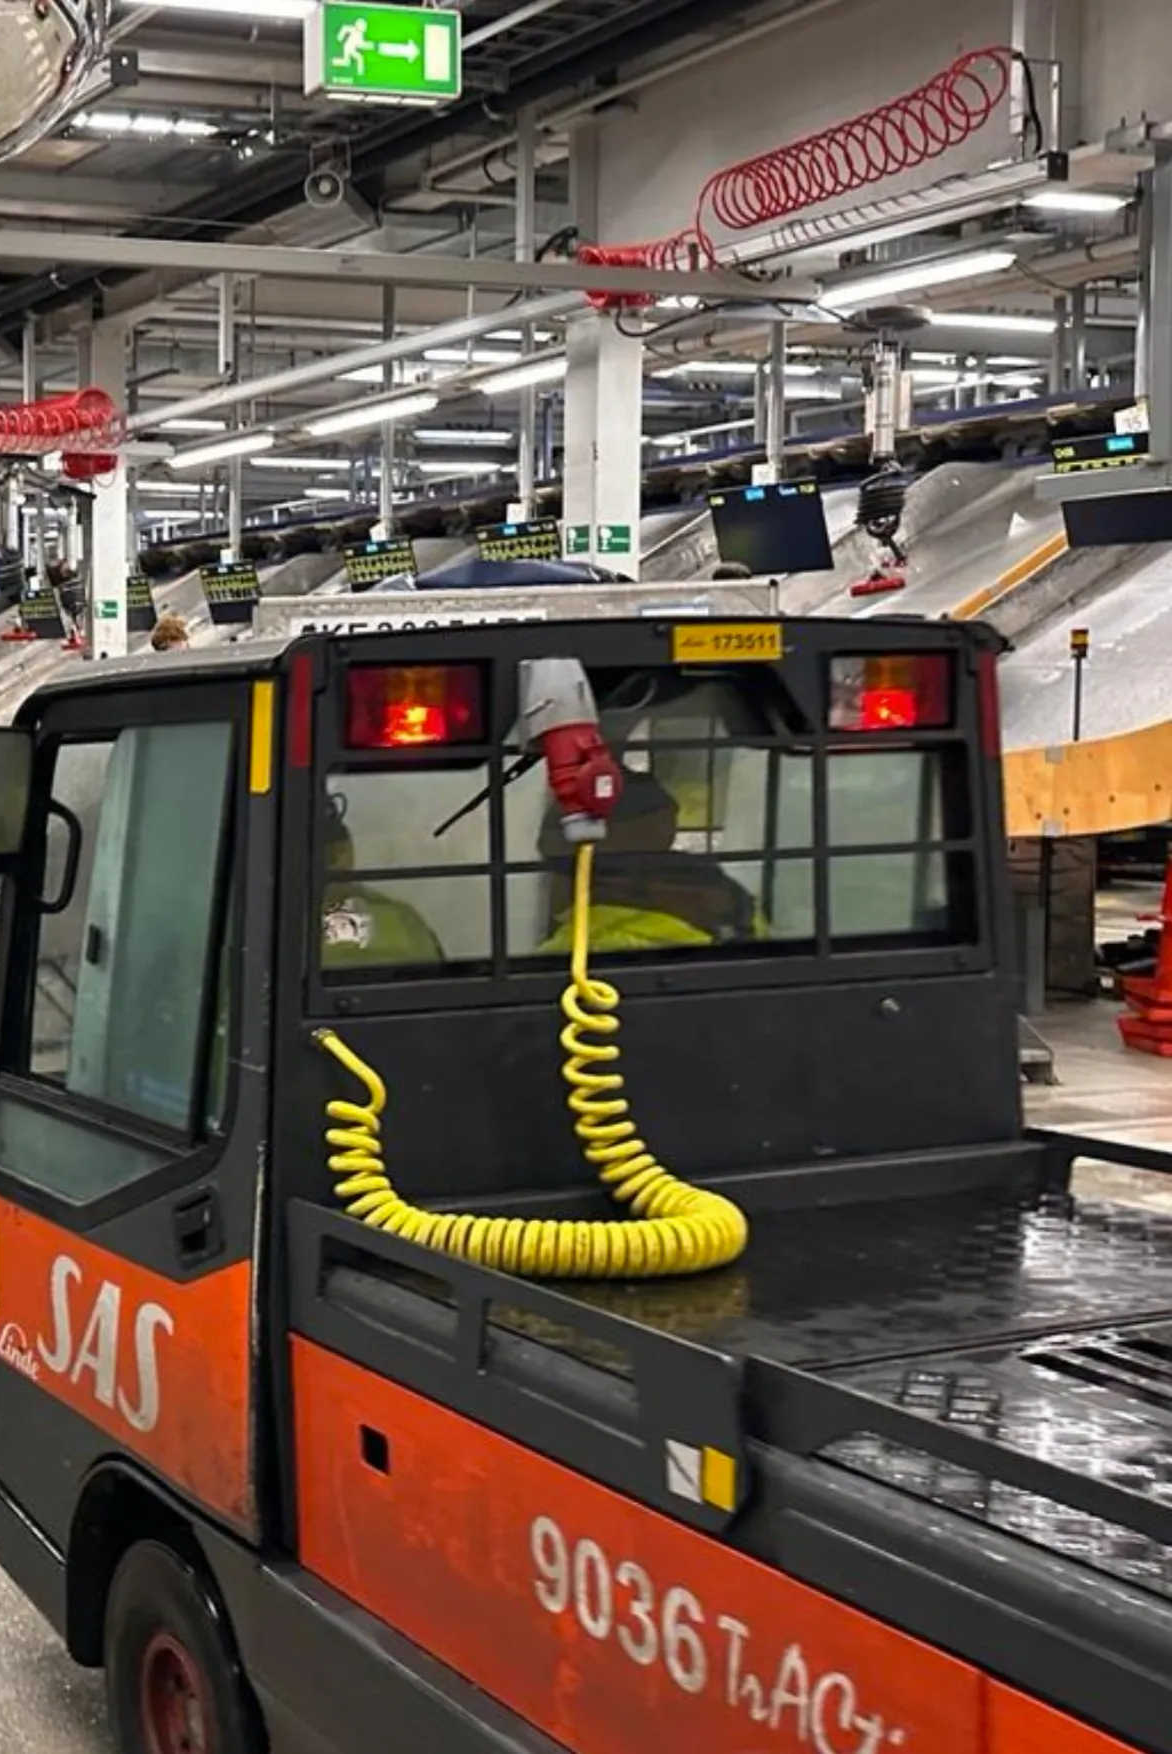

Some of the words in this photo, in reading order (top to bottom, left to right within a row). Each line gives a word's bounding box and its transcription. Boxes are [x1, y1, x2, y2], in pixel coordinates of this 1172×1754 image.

[713, 633, 776, 650] 173511
[36, 1254, 174, 1432] SAS
[531, 1515, 707, 1694] 9036
